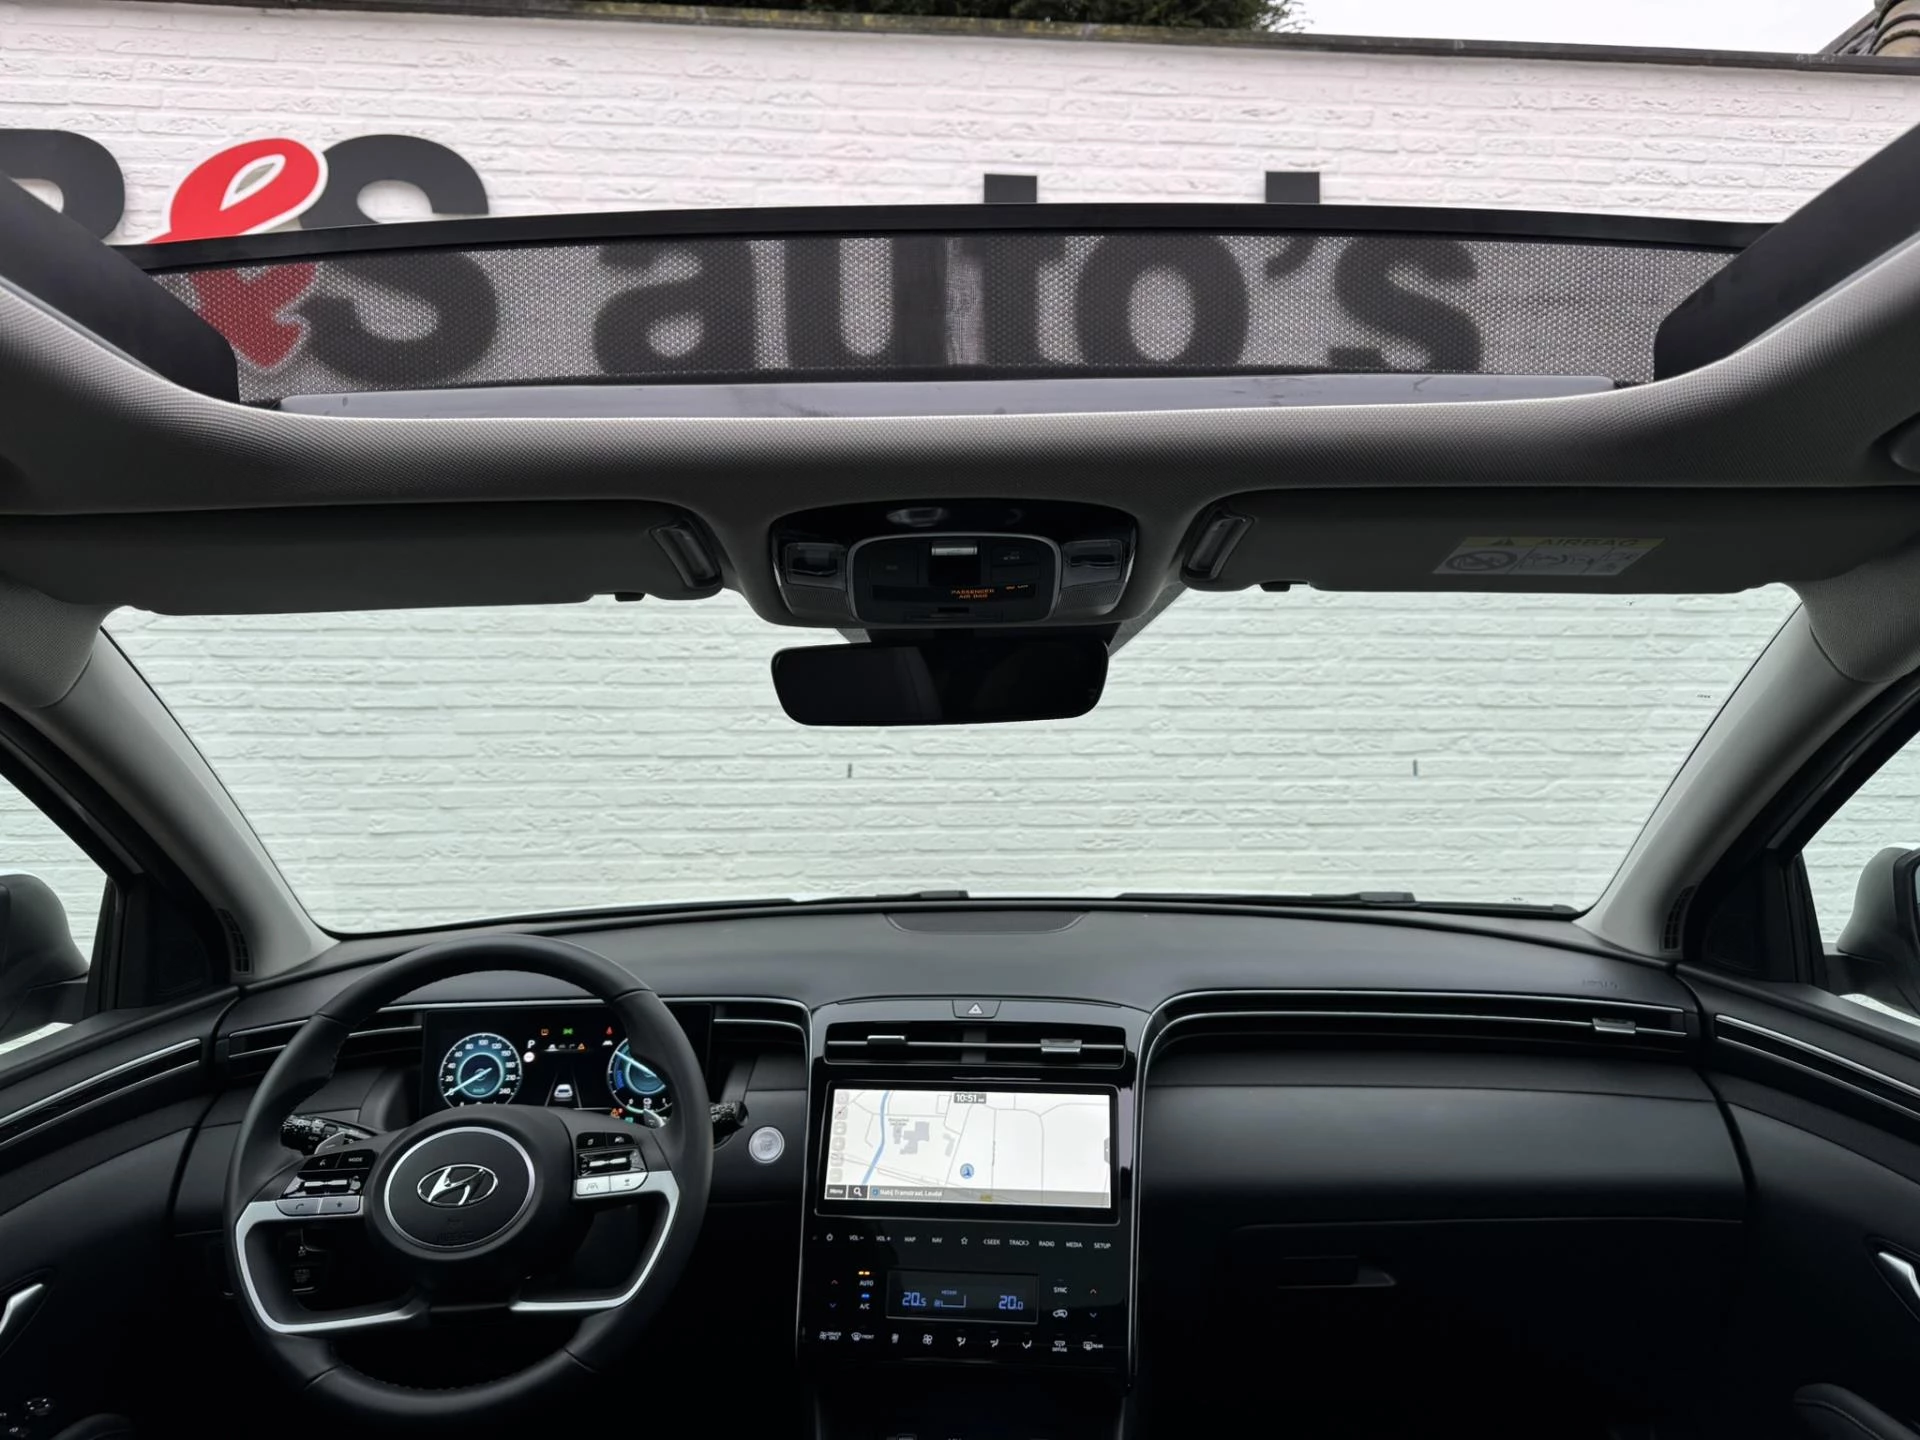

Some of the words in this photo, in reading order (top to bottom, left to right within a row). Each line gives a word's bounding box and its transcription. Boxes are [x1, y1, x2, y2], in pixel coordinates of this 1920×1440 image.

[527, 1039, 536, 1049] P
[956, 1093, 977, 1102] 10:51
[1038, 1240, 1056, 1248] RADIO
[1065, 1241, 1083, 1249] MEDIA
[1093, 1242, 1112, 1250] SETUP
[858, 1279, 875, 1287] AUTO
[1053, 1286, 1068, 1294] SYNC
